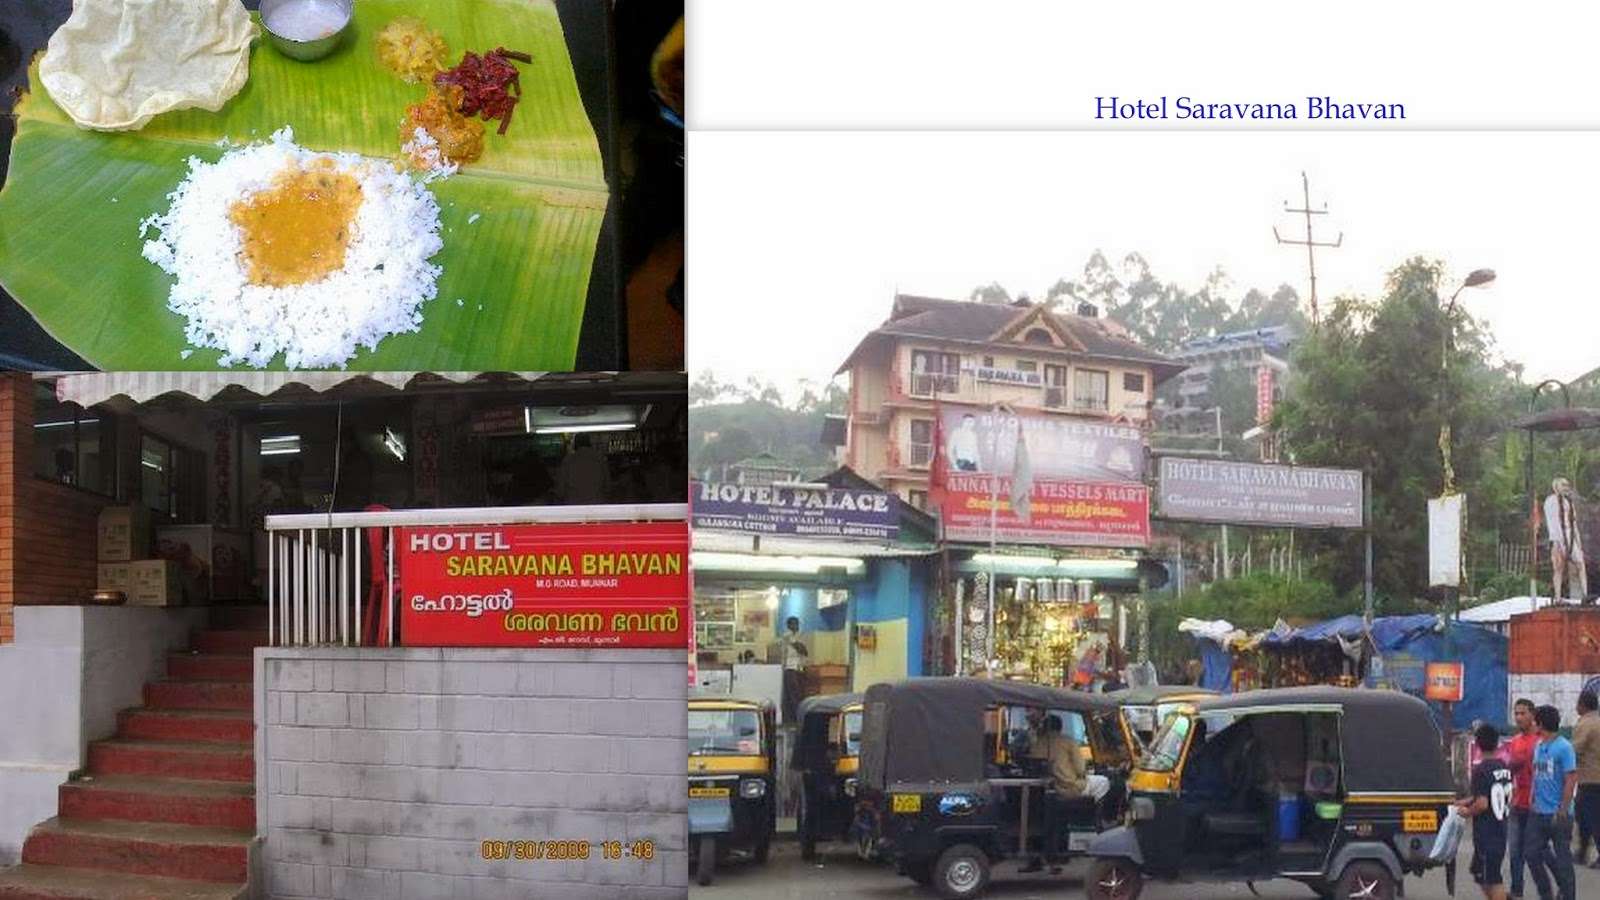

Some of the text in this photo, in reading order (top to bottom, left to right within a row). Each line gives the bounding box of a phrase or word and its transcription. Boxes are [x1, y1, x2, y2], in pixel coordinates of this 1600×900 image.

[1168, 462, 1214, 482] HOTEL
[702, 482, 785, 507] HOTEL
[792, 489, 889, 513] PALACE
[1040, 483, 1100, 501] VESSELS
[1105, 486, 1146, 504] MART
[410, 532, 511, 551] HOTEL
[447, 553, 681, 576] SARAVANA BHAVAN
